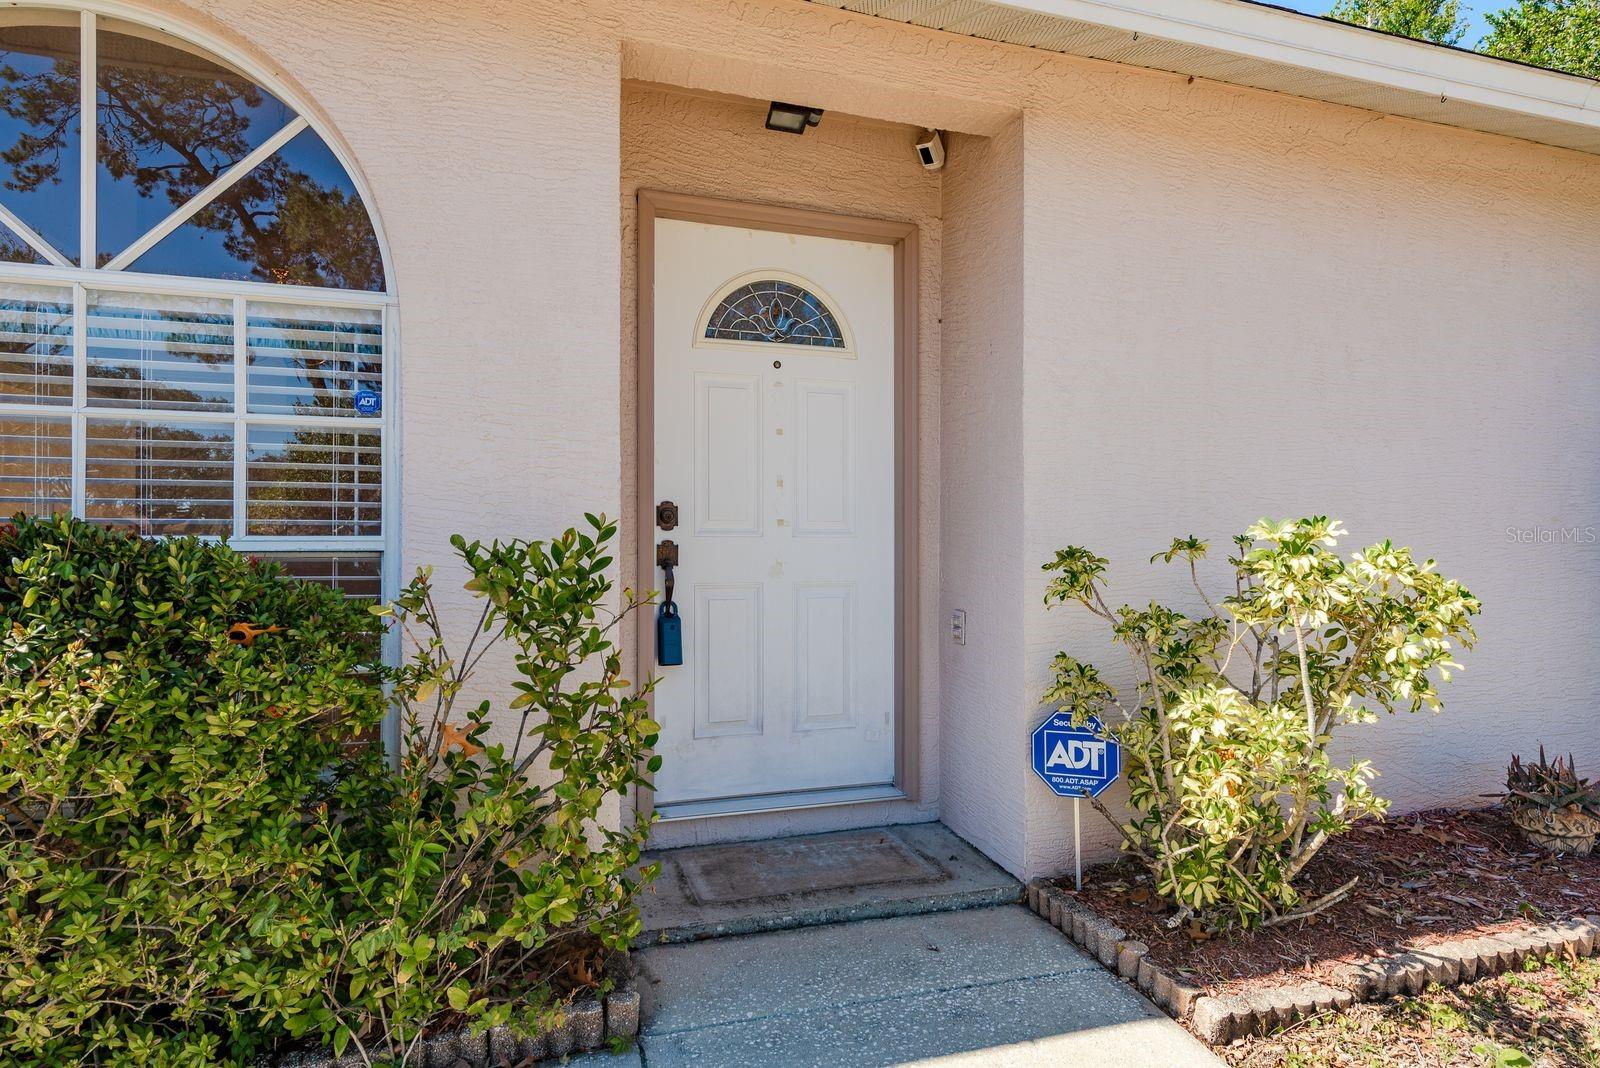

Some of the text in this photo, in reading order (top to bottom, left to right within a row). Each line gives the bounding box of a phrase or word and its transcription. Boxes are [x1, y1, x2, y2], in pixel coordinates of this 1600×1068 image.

[359, 397, 377, 406] ADT
[1053, 718, 1096, 730] Secu by
